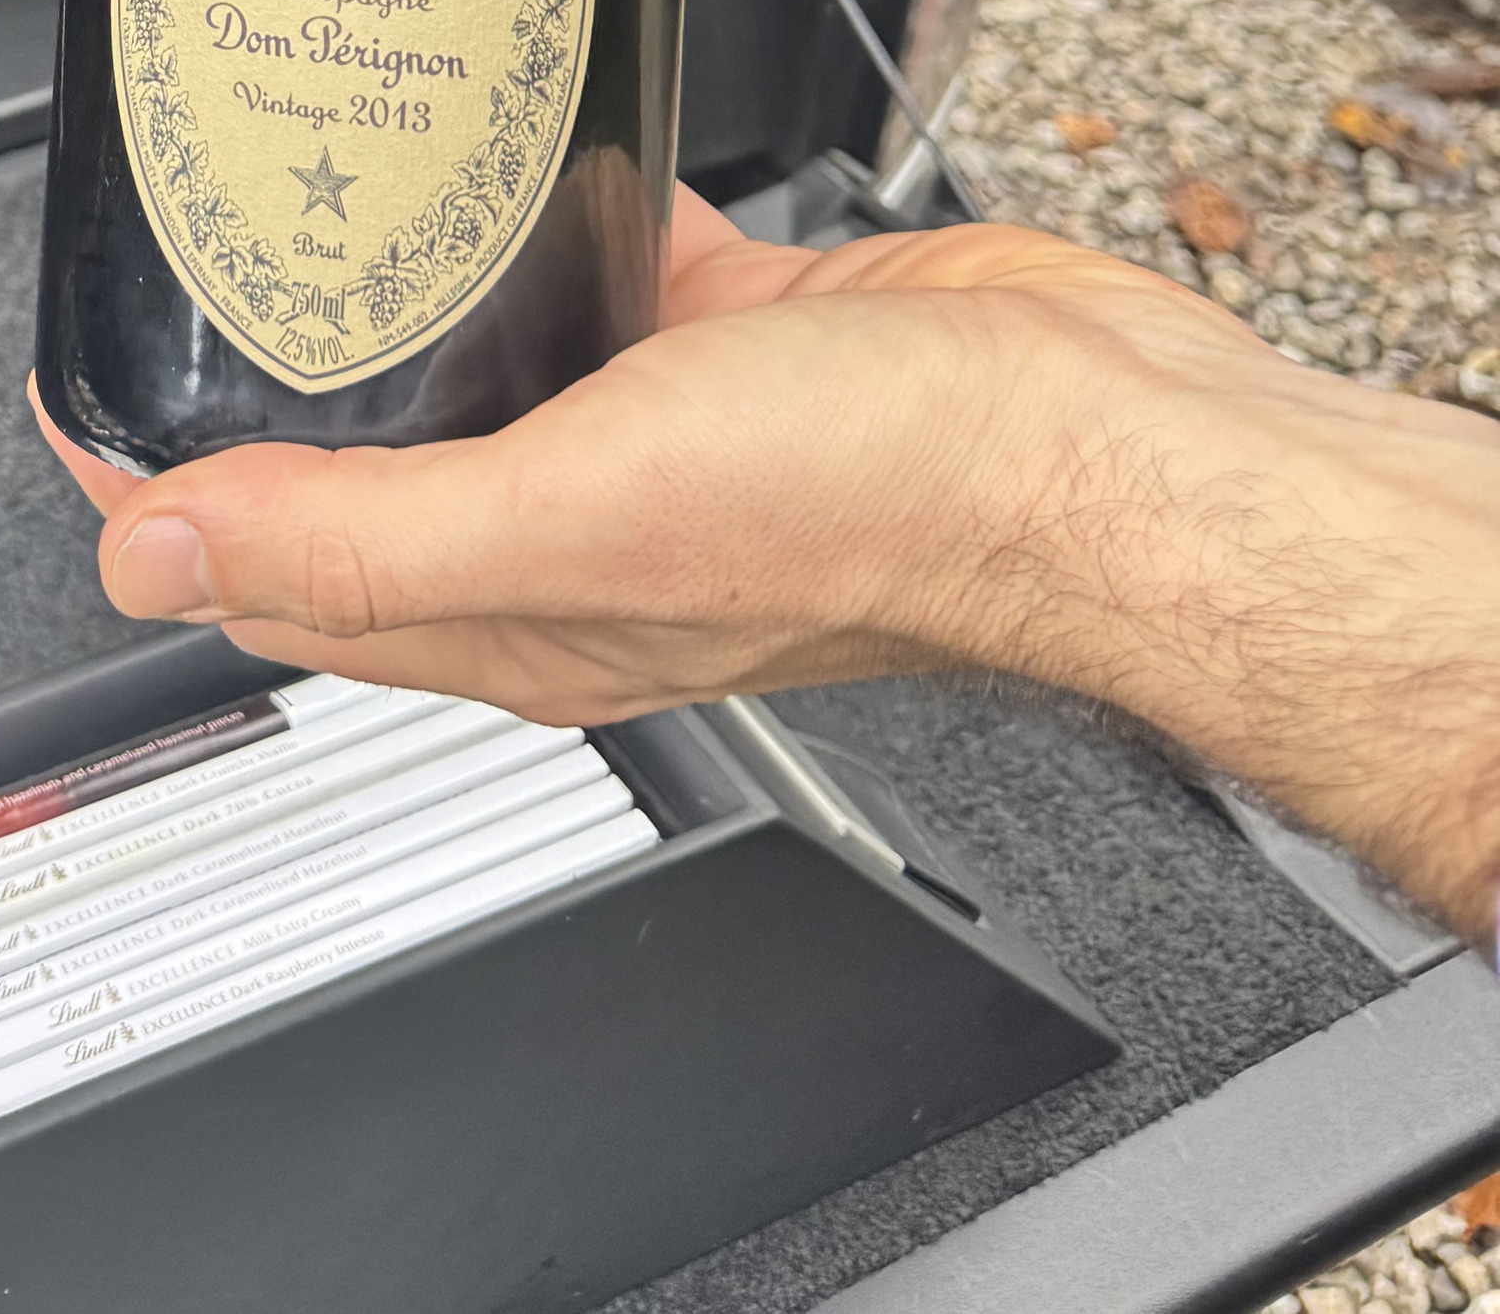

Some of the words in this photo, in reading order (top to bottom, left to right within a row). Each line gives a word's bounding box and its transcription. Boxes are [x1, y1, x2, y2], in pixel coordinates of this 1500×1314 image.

[205, 2, 296, 59] Dom
[300, 15, 469, 90] Pérignon
[232, 80, 343, 131] Vintage
[348, 94, 432, 133] 2013
[127, 85, 148, 149] CHAMPAGNE
[155, 189, 186, 245] CHANDON
[218, 293, 255, 332] FRANCE
[292, 231, 348, 262] Brut
[474, 227, 510, 273] PRODUCT
[507, 211, 519, 228] OF
[514, 175, 539, 219] FRANCE
[535, 126, 559, 170] PRODUIT
[5, 777, 63, 808] hazelnuts
[62, 766, 87, 785] and
[156, 722, 208, 750] hazelnut
[59, 790, 161, 837] EXCELLENCE
[165, 774, 201, 796] Dark
[43, 886, 148, 934] EXCELLENCE
[152, 872, 189, 892] Dark
[283, 808, 349, 844] Hazelnut
[73, 828, 178, 874] EXCELLENCE
[178, 808, 220, 832] Dark
[48, 988, 103, 1028] Lindt
[127, 943, 237, 997] EXCELLENCE
[241, 928, 274, 950] Milk
[274, 915, 310, 938] Extra
[309, 894, 364, 925] Creamy
[59, 926, 165, 975] EXCELLENCE
[170, 909, 207, 932] Dark
[209, 870, 302, 915] Caramelised
[303, 843, 369, 878] Hazelnut
[63, 1028, 119, 1068] Lindt
[141, 989, 230, 1037] EXCELLENCE
[229, 978, 266, 1000] Dark
[264, 949, 335, 983] Raspberry
[334, 928, 387, 958] Intense
